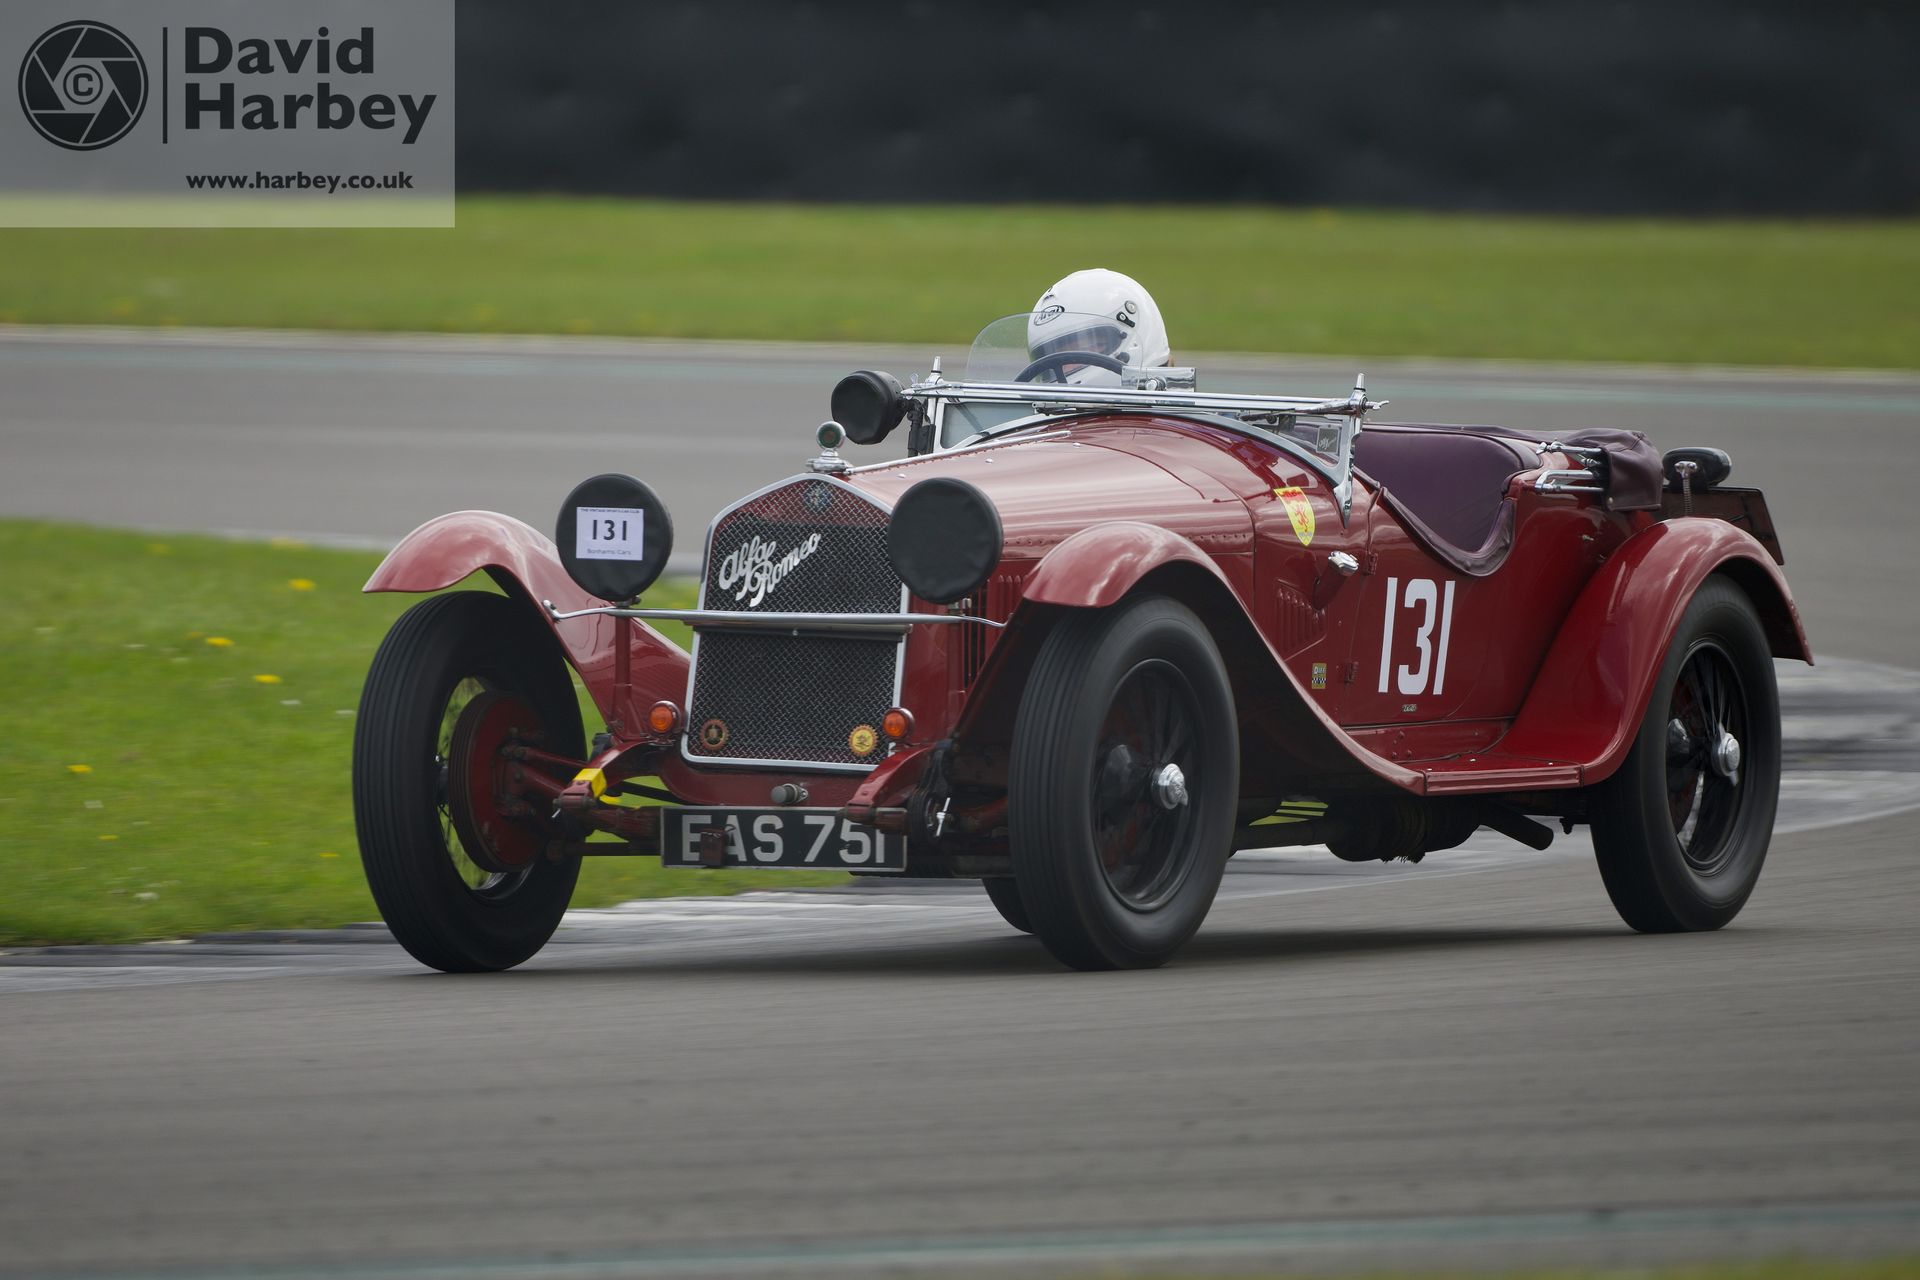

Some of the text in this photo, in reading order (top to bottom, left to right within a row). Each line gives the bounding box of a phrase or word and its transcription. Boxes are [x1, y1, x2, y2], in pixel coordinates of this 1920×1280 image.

[592, 519, 627, 541] 131
[718, 535, 777, 601] Alfa
[749, 533, 821, 607] Romeo
[1378, 577, 1456, 695] 131
[682, 814, 885, 864] EAS 751
